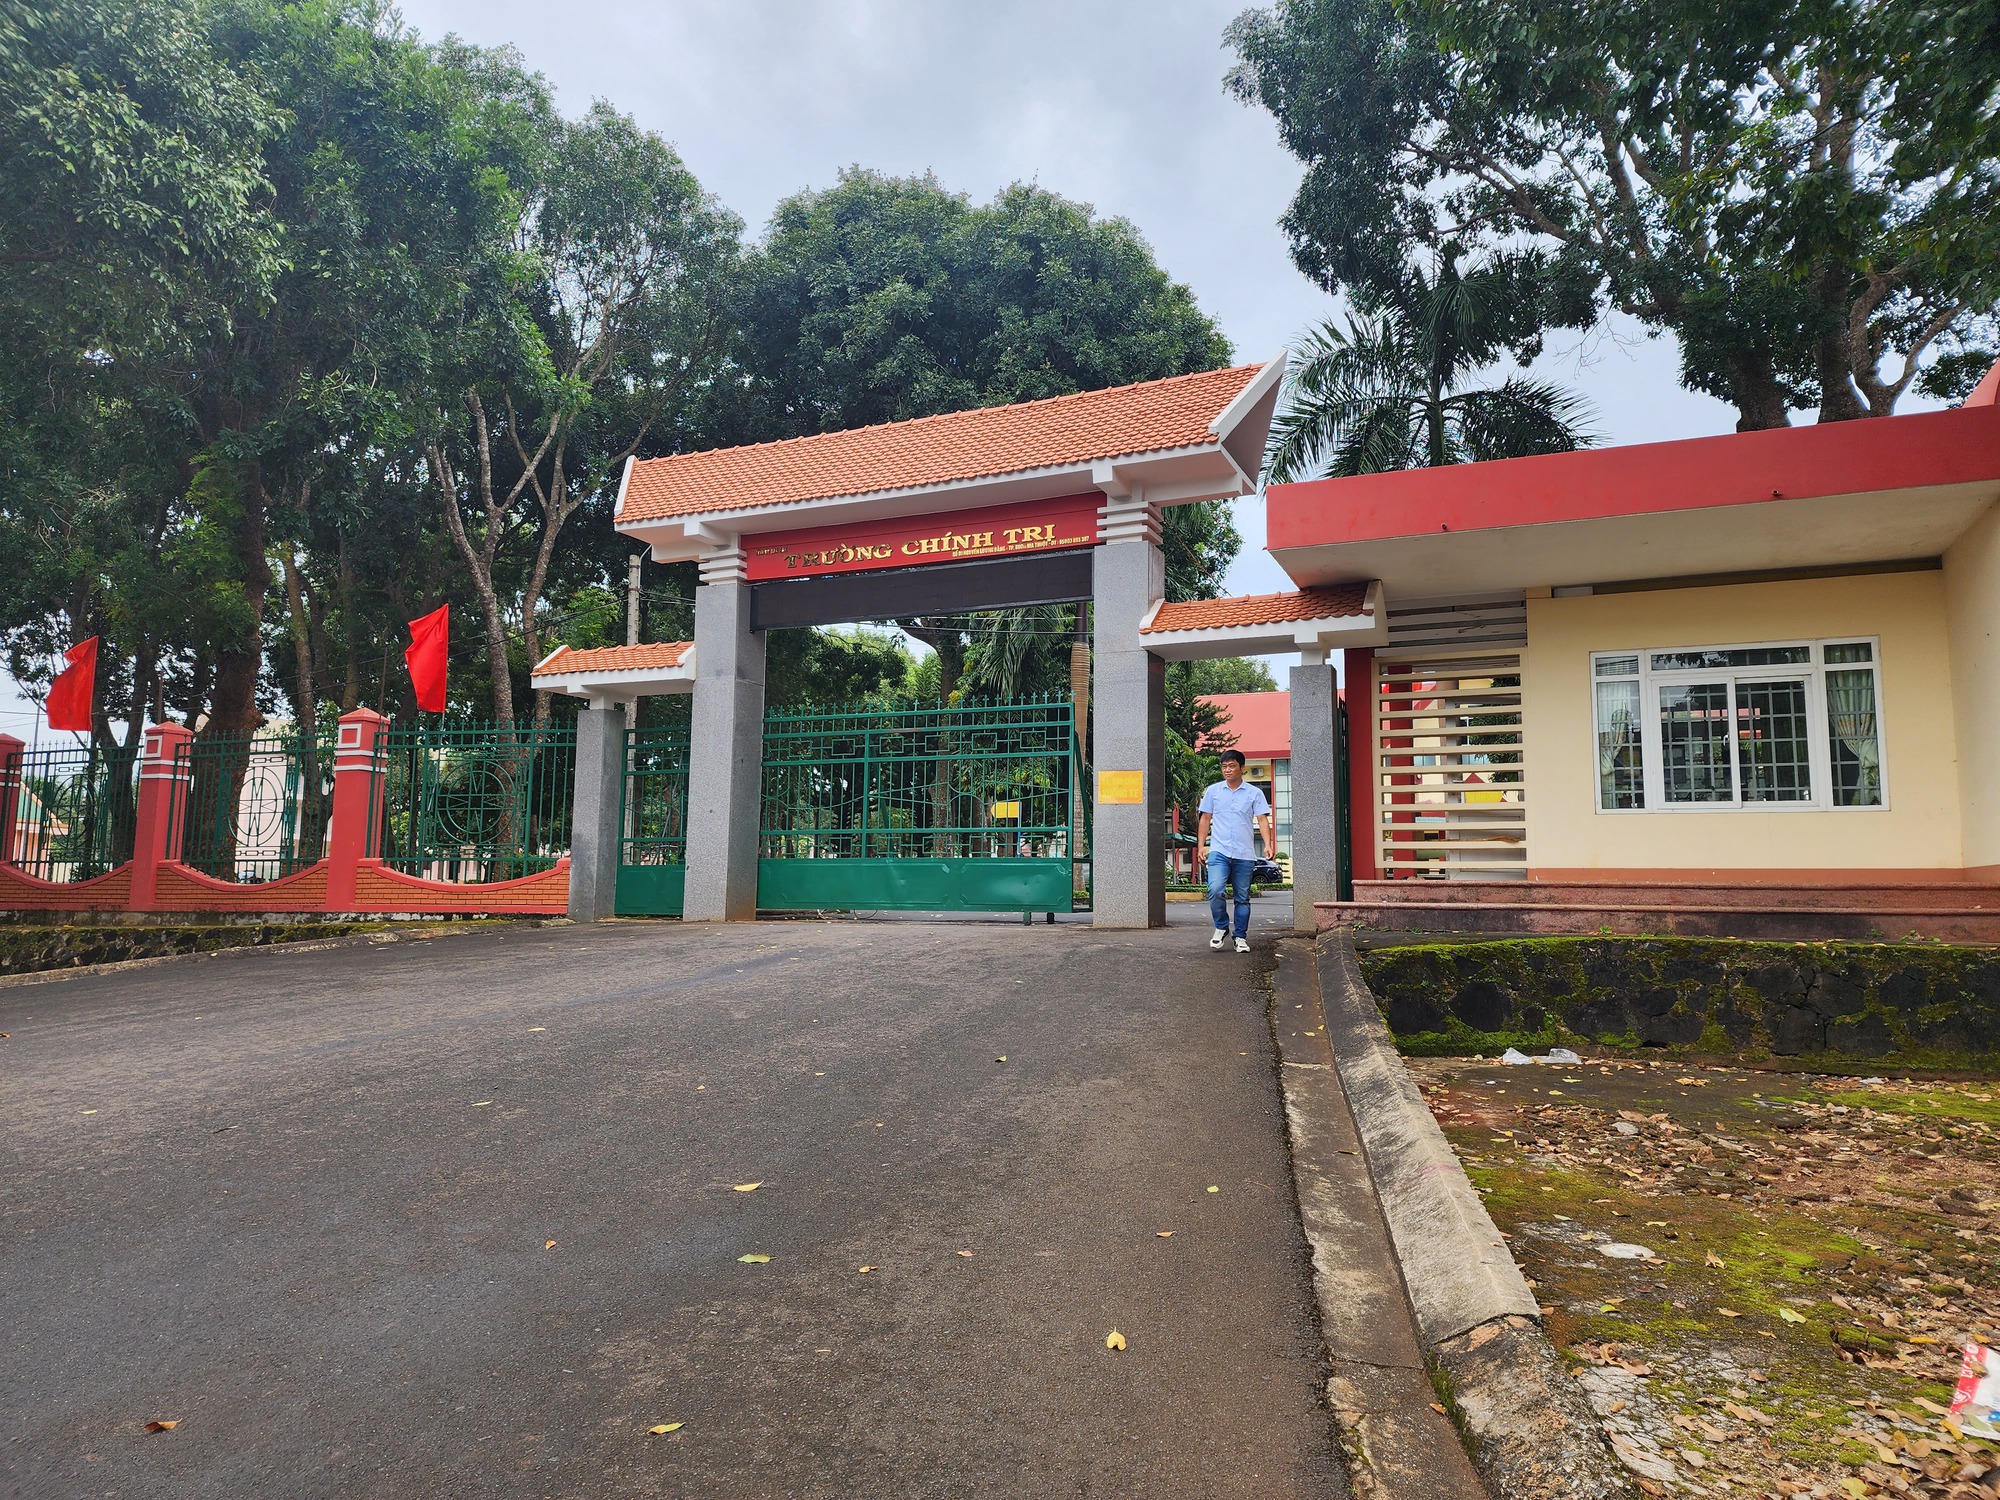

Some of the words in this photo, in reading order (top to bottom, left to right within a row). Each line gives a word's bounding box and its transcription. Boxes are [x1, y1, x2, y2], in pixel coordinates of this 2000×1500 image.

[784, 543, 893, 568] TRƯỜNG
[901, 531, 994, 555] CHÍNH
[1003, 524, 1056, 544] TRỊ
